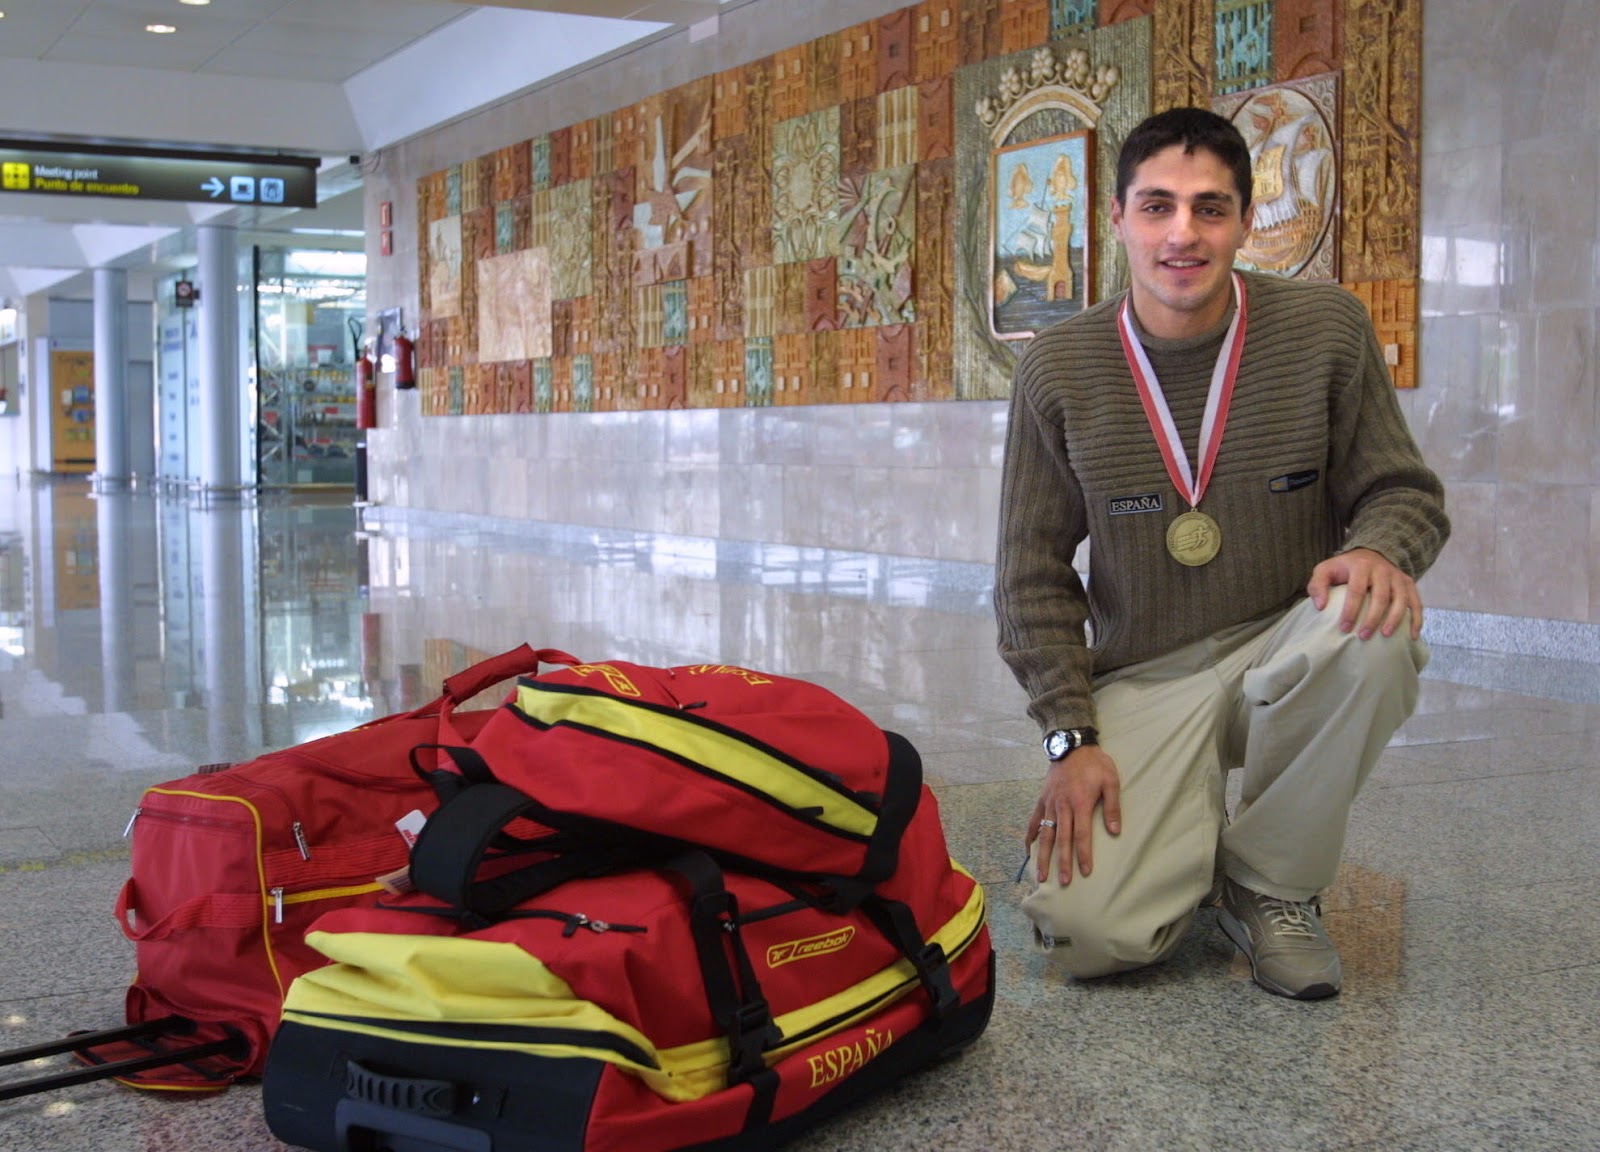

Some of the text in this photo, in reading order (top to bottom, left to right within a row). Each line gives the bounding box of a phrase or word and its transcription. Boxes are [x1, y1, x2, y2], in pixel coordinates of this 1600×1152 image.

[34, 165, 98, 180] Meeting point
[34, 177, 139, 195] Punto de encuentro
[1111, 497, 1160, 511] ESPAÑA
[807, 1028, 893, 1088] ESPAÑA
